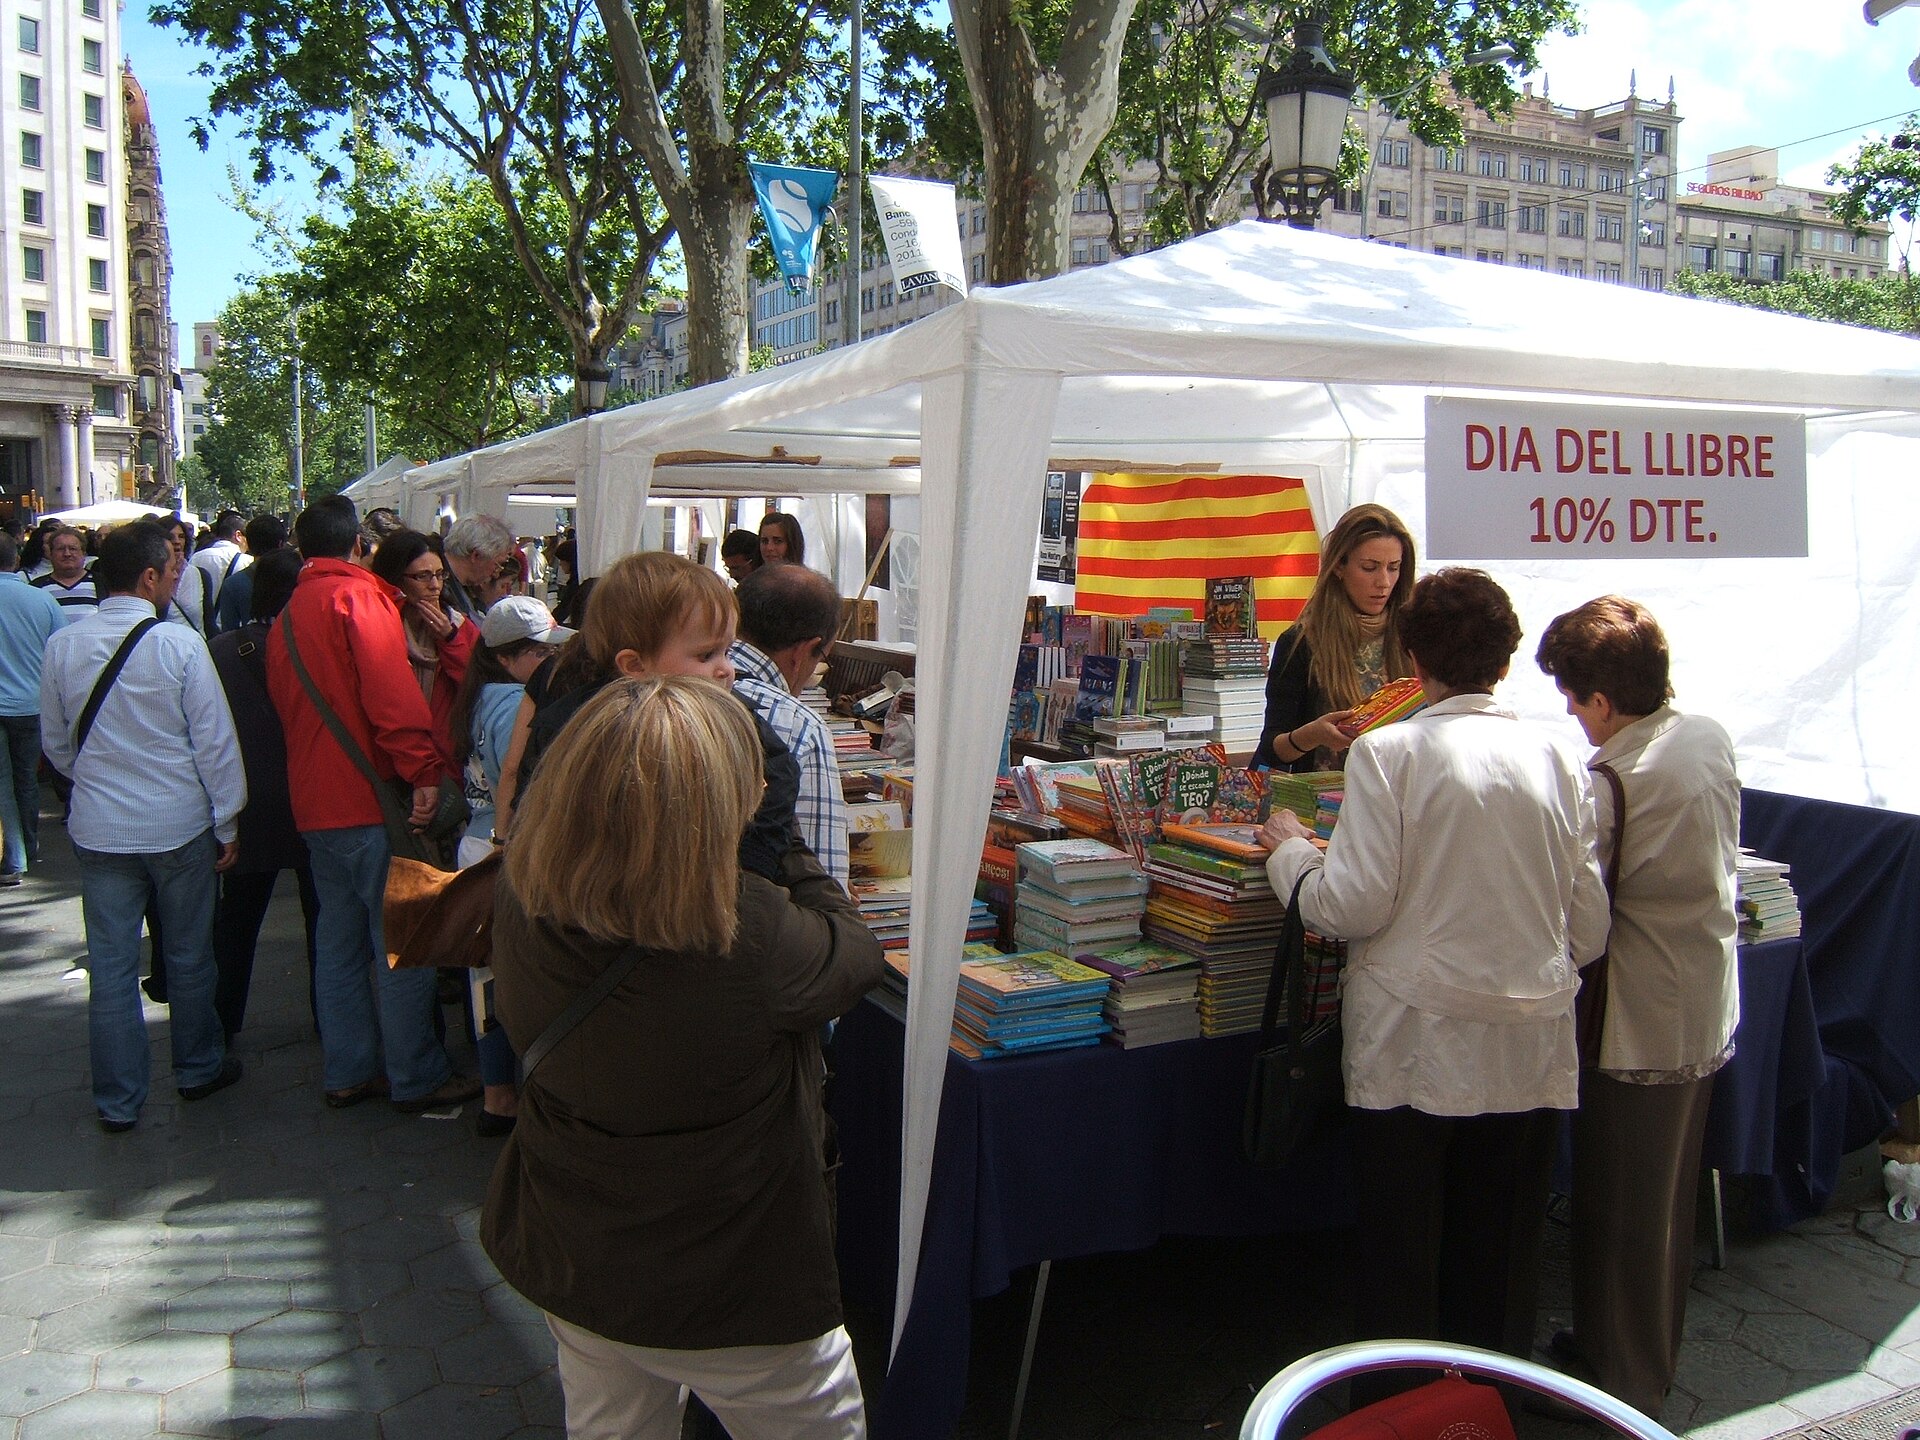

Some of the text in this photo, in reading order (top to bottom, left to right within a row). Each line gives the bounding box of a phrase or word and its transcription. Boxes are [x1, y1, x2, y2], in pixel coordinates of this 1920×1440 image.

[1687, 182, 1763, 201] SEGUROS BILBAO
[1465, 424, 1774, 478] DIA DEL LLIBRE
[1529, 497, 1718, 544] 10% DTE.
[1181, 769, 1209, 783] ¿Dónde
[1187, 781, 1214, 790] esconde
[1181, 790, 1210, 807] TEO?
